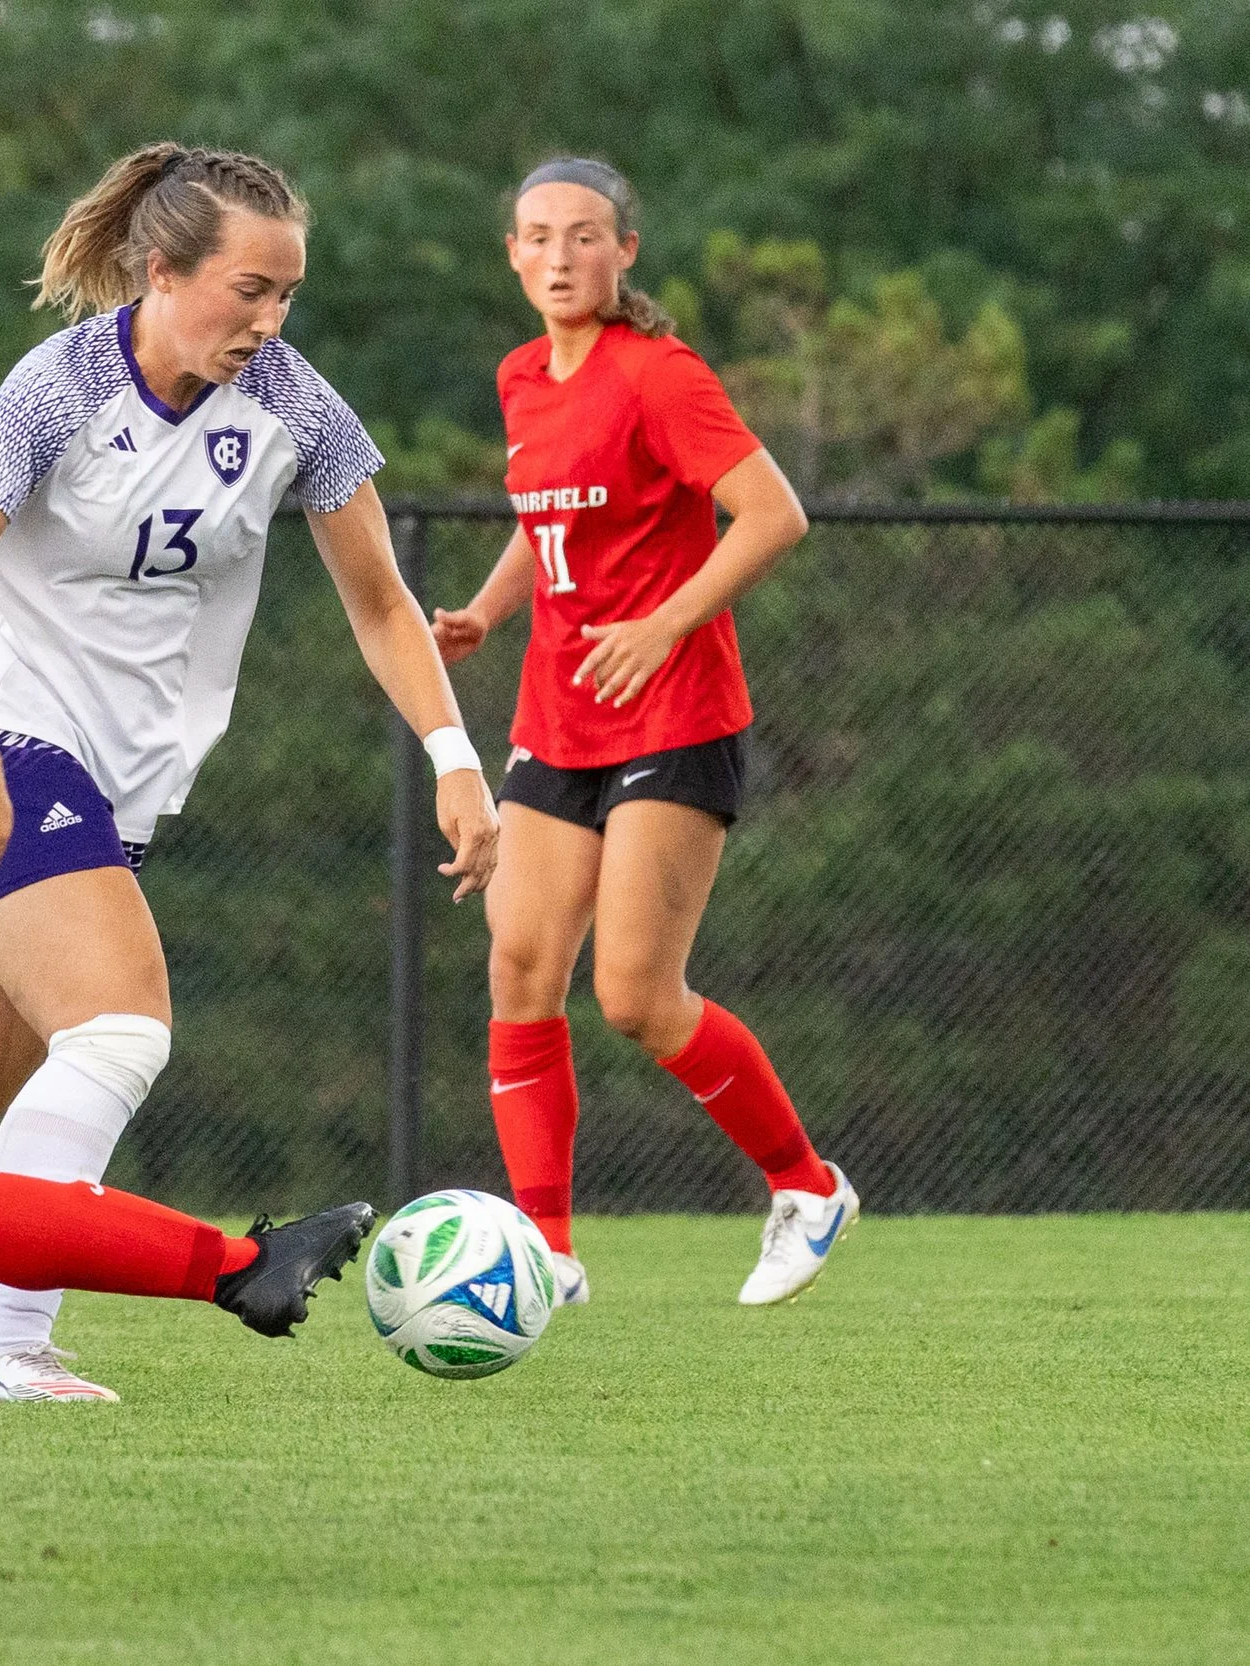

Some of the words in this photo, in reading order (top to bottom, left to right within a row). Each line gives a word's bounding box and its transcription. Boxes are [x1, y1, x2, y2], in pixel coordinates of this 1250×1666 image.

[510, 485, 607, 515] AIRFIELD
[128, 508, 204, 581] 13
[533, 524, 577, 598] 11
[40, 815, 83, 833] adidas
